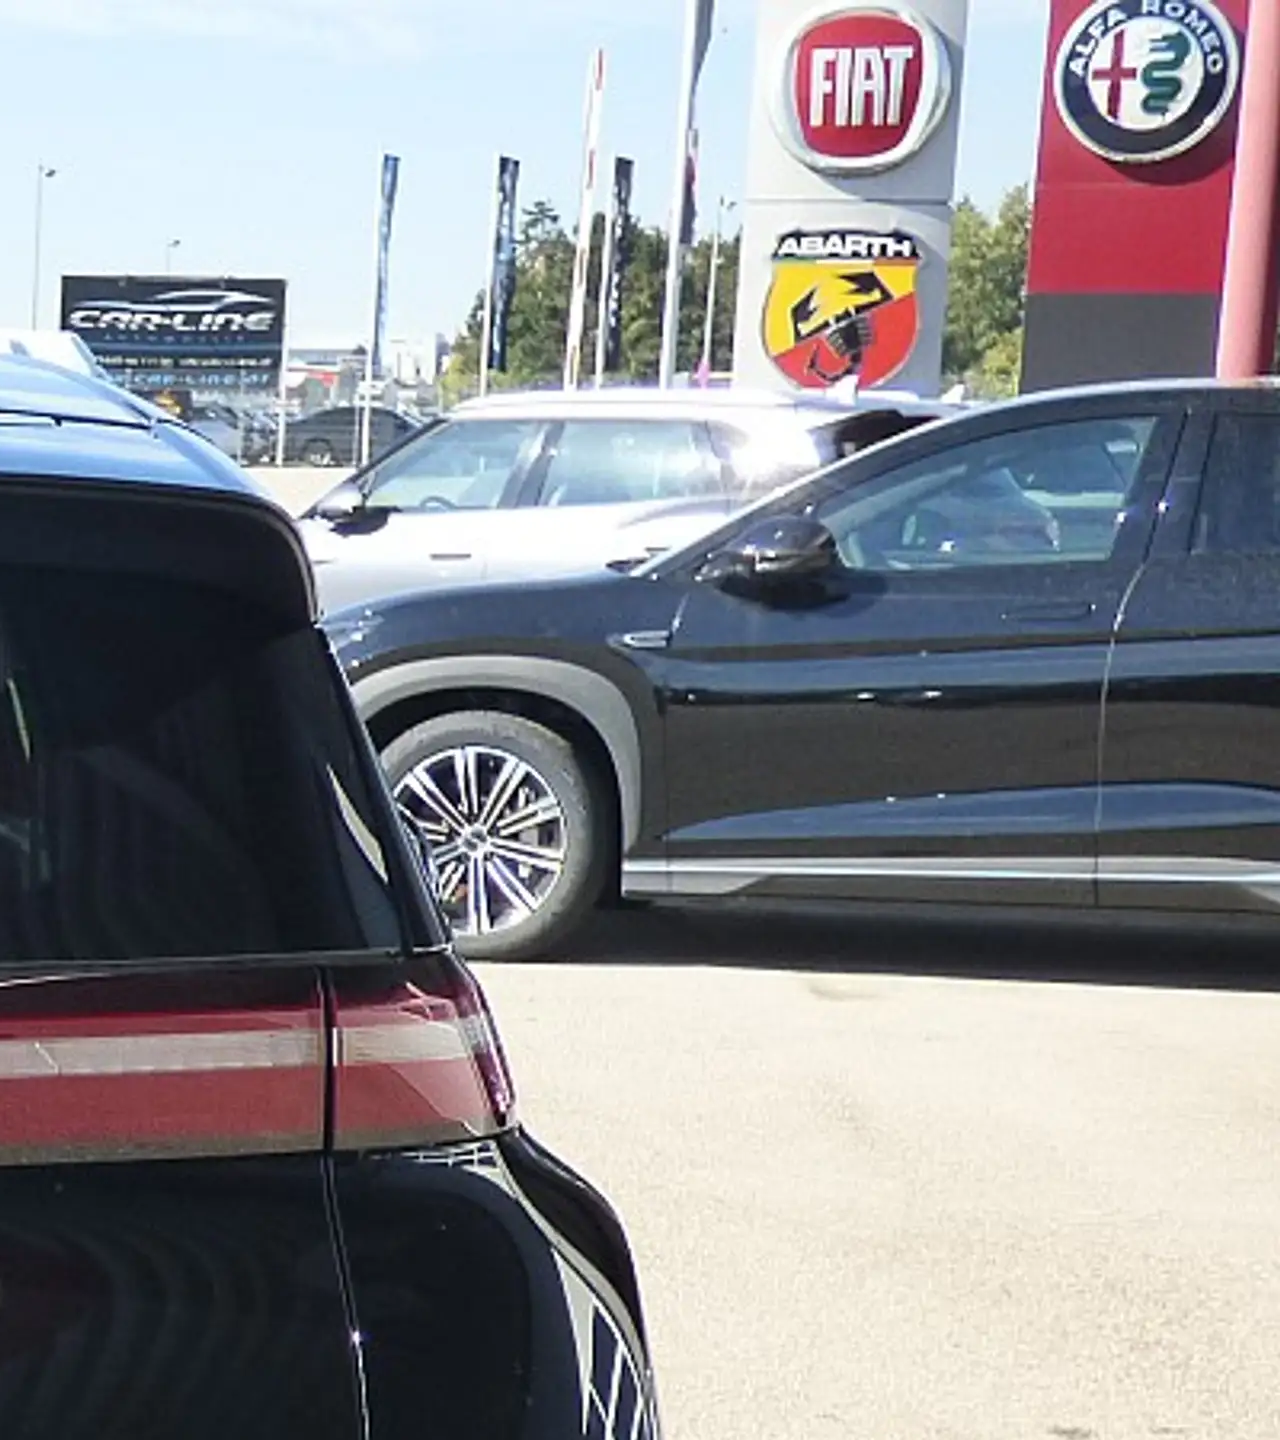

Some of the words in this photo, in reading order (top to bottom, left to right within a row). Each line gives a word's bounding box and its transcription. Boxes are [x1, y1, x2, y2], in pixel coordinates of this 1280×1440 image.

[1069, 7, 1127, 77] ALFA
[1141, 0, 1224, 74] ROMEO
[809, 44, 914, 127] FIAT
[778, 234, 911, 257] ABARTH
[69, 309, 276, 332] CAR-LINE
